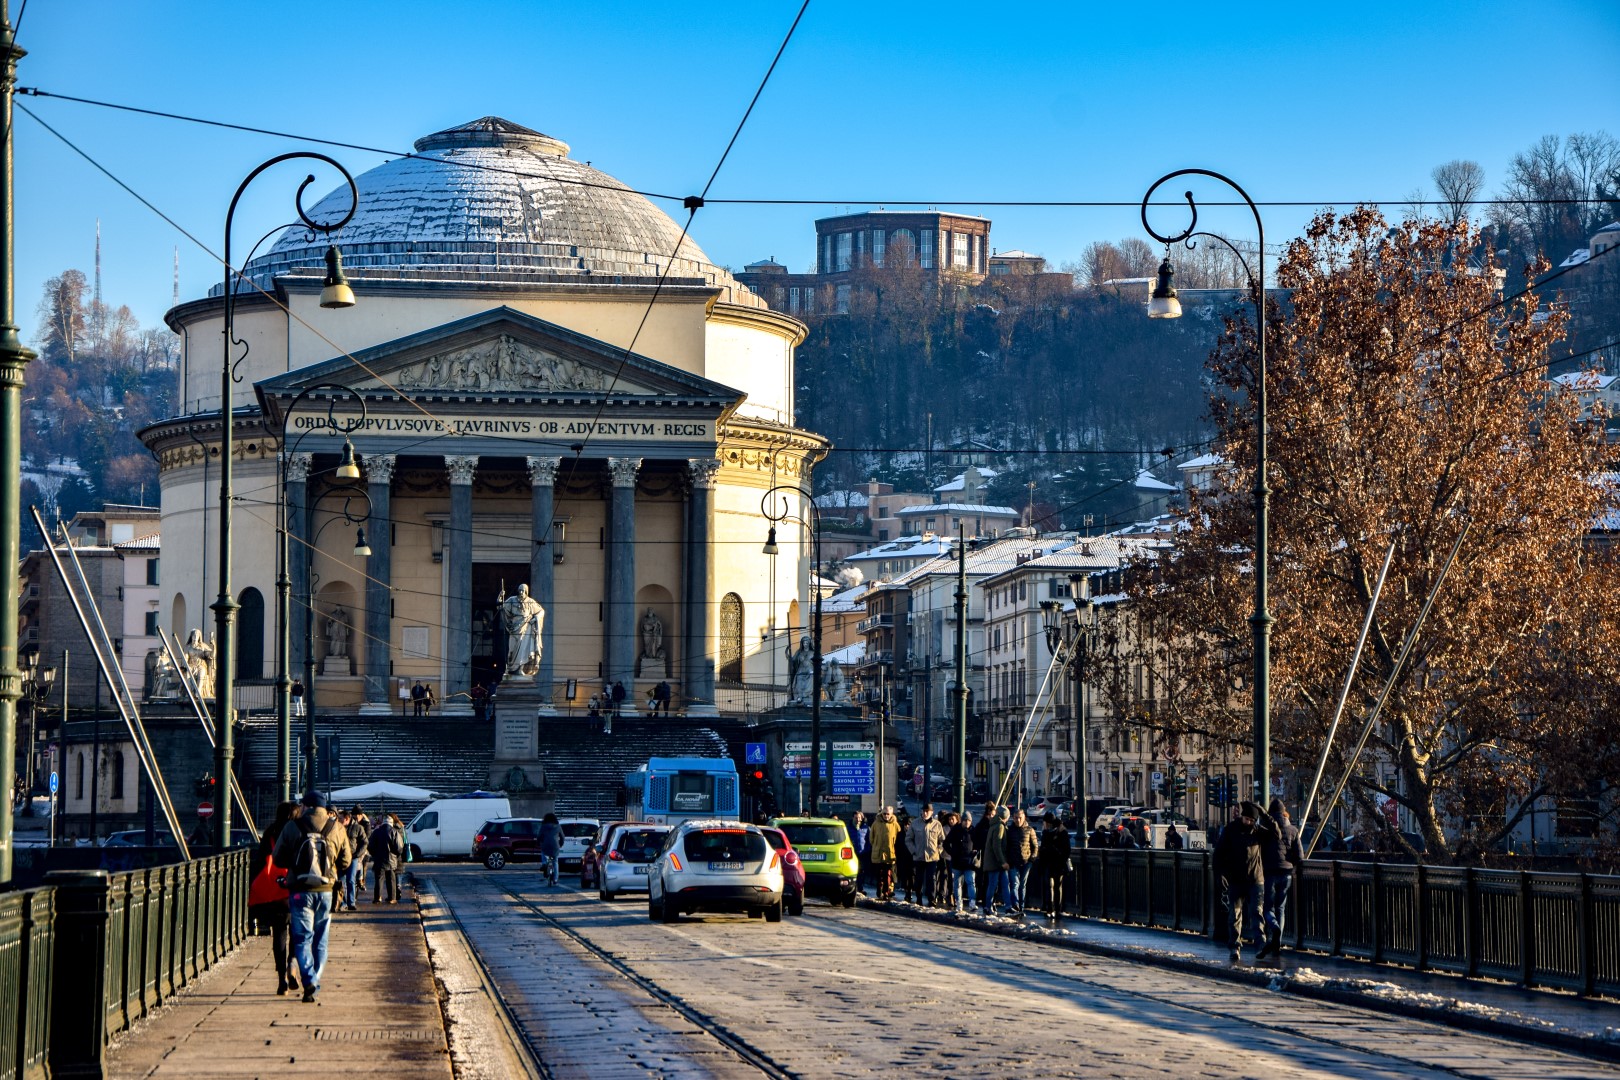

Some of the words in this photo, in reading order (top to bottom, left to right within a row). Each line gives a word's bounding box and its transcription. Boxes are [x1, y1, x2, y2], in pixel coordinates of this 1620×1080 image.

[295, 416, 338, 430] ORDO
[347, 417, 445, 433] POPVLVSQVE
[453, 419, 530, 433] TAVRINVS
[539, 421, 558, 434] OB
[565, 422, 654, 436] ADVENTVM
[664, 424, 706, 436] REGIS
